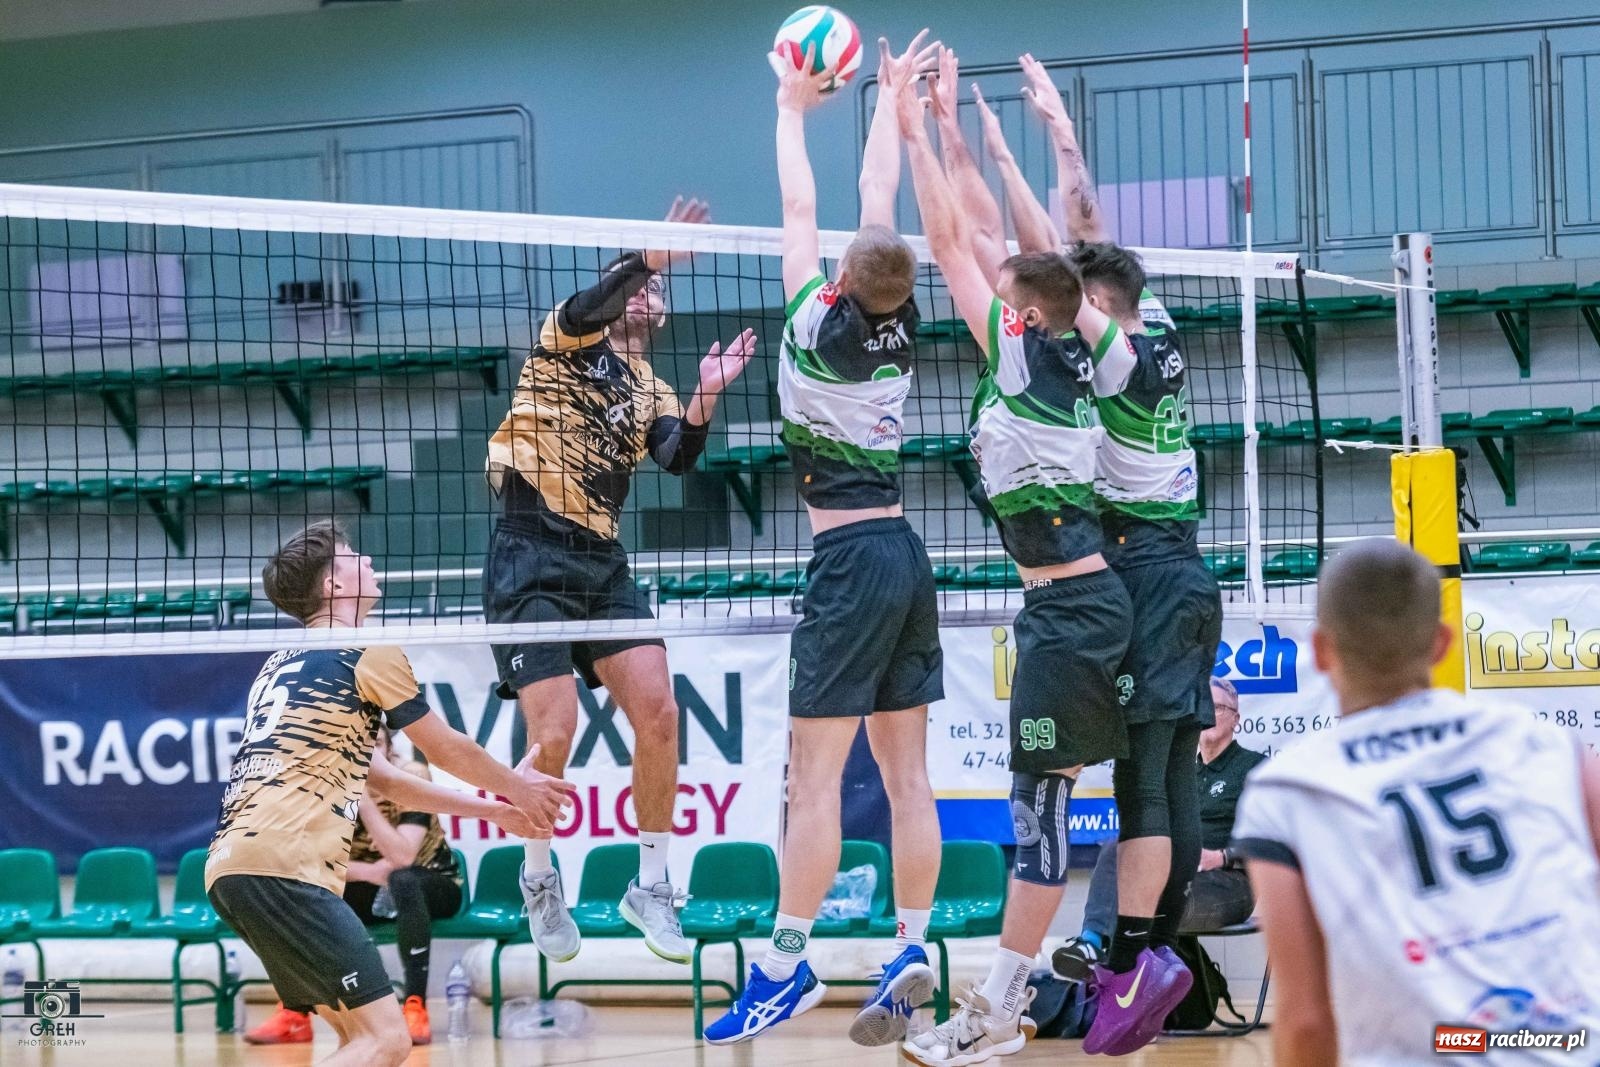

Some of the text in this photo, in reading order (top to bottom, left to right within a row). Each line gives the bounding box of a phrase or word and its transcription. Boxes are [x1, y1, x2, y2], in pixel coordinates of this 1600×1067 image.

[950, 722, 1004, 740] tel. 32
[1020, 718, 1056, 751] 99
[1271, 715, 1306, 735] 363
[963, 752, 1011, 769] 47-4
[1379, 767, 1516, 897] 15
